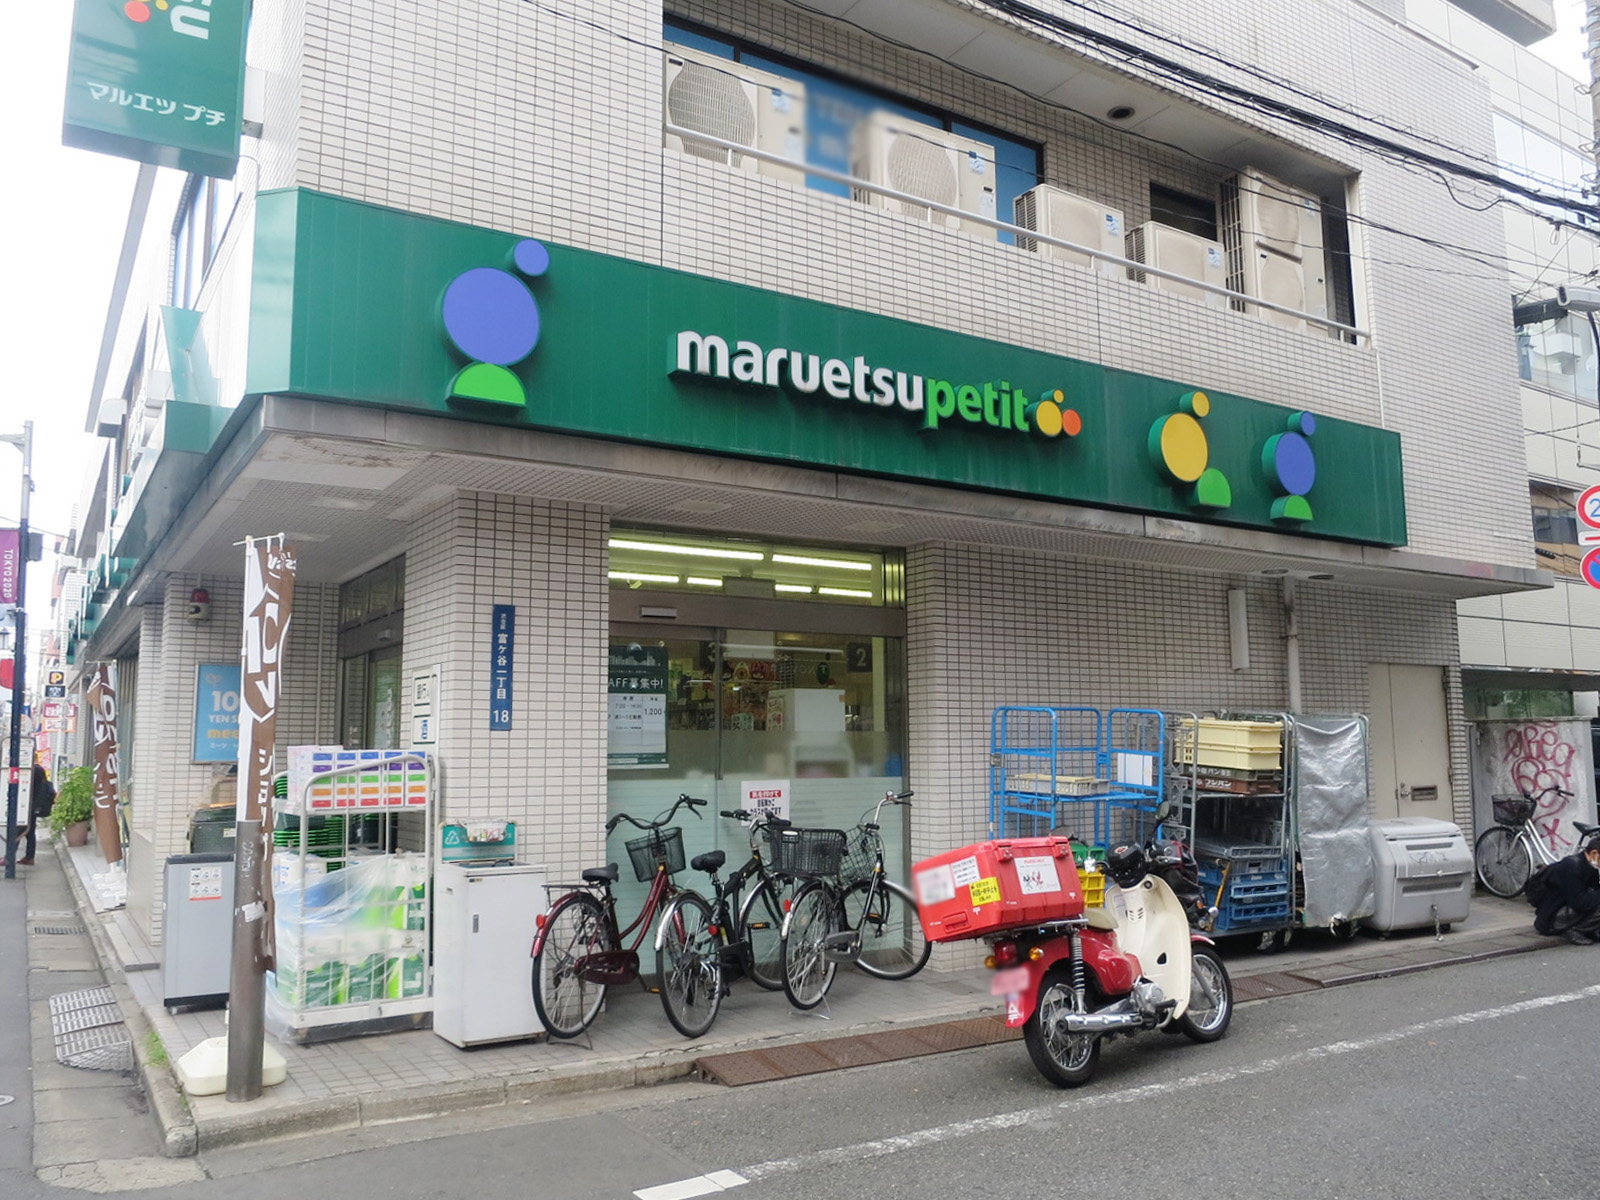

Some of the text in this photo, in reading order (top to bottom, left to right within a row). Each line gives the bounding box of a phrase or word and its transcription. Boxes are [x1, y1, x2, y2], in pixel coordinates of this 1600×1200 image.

[87, 81, 226, 126] マルエツ プチ
[2, 549, 14, 598] TOKYO 2020
[856, 648, 867, 667] 2
[209, 714, 230, 723] YEN
[493, 710, 509, 723] 18
[1205, 778, 1232, 787] フジパン
